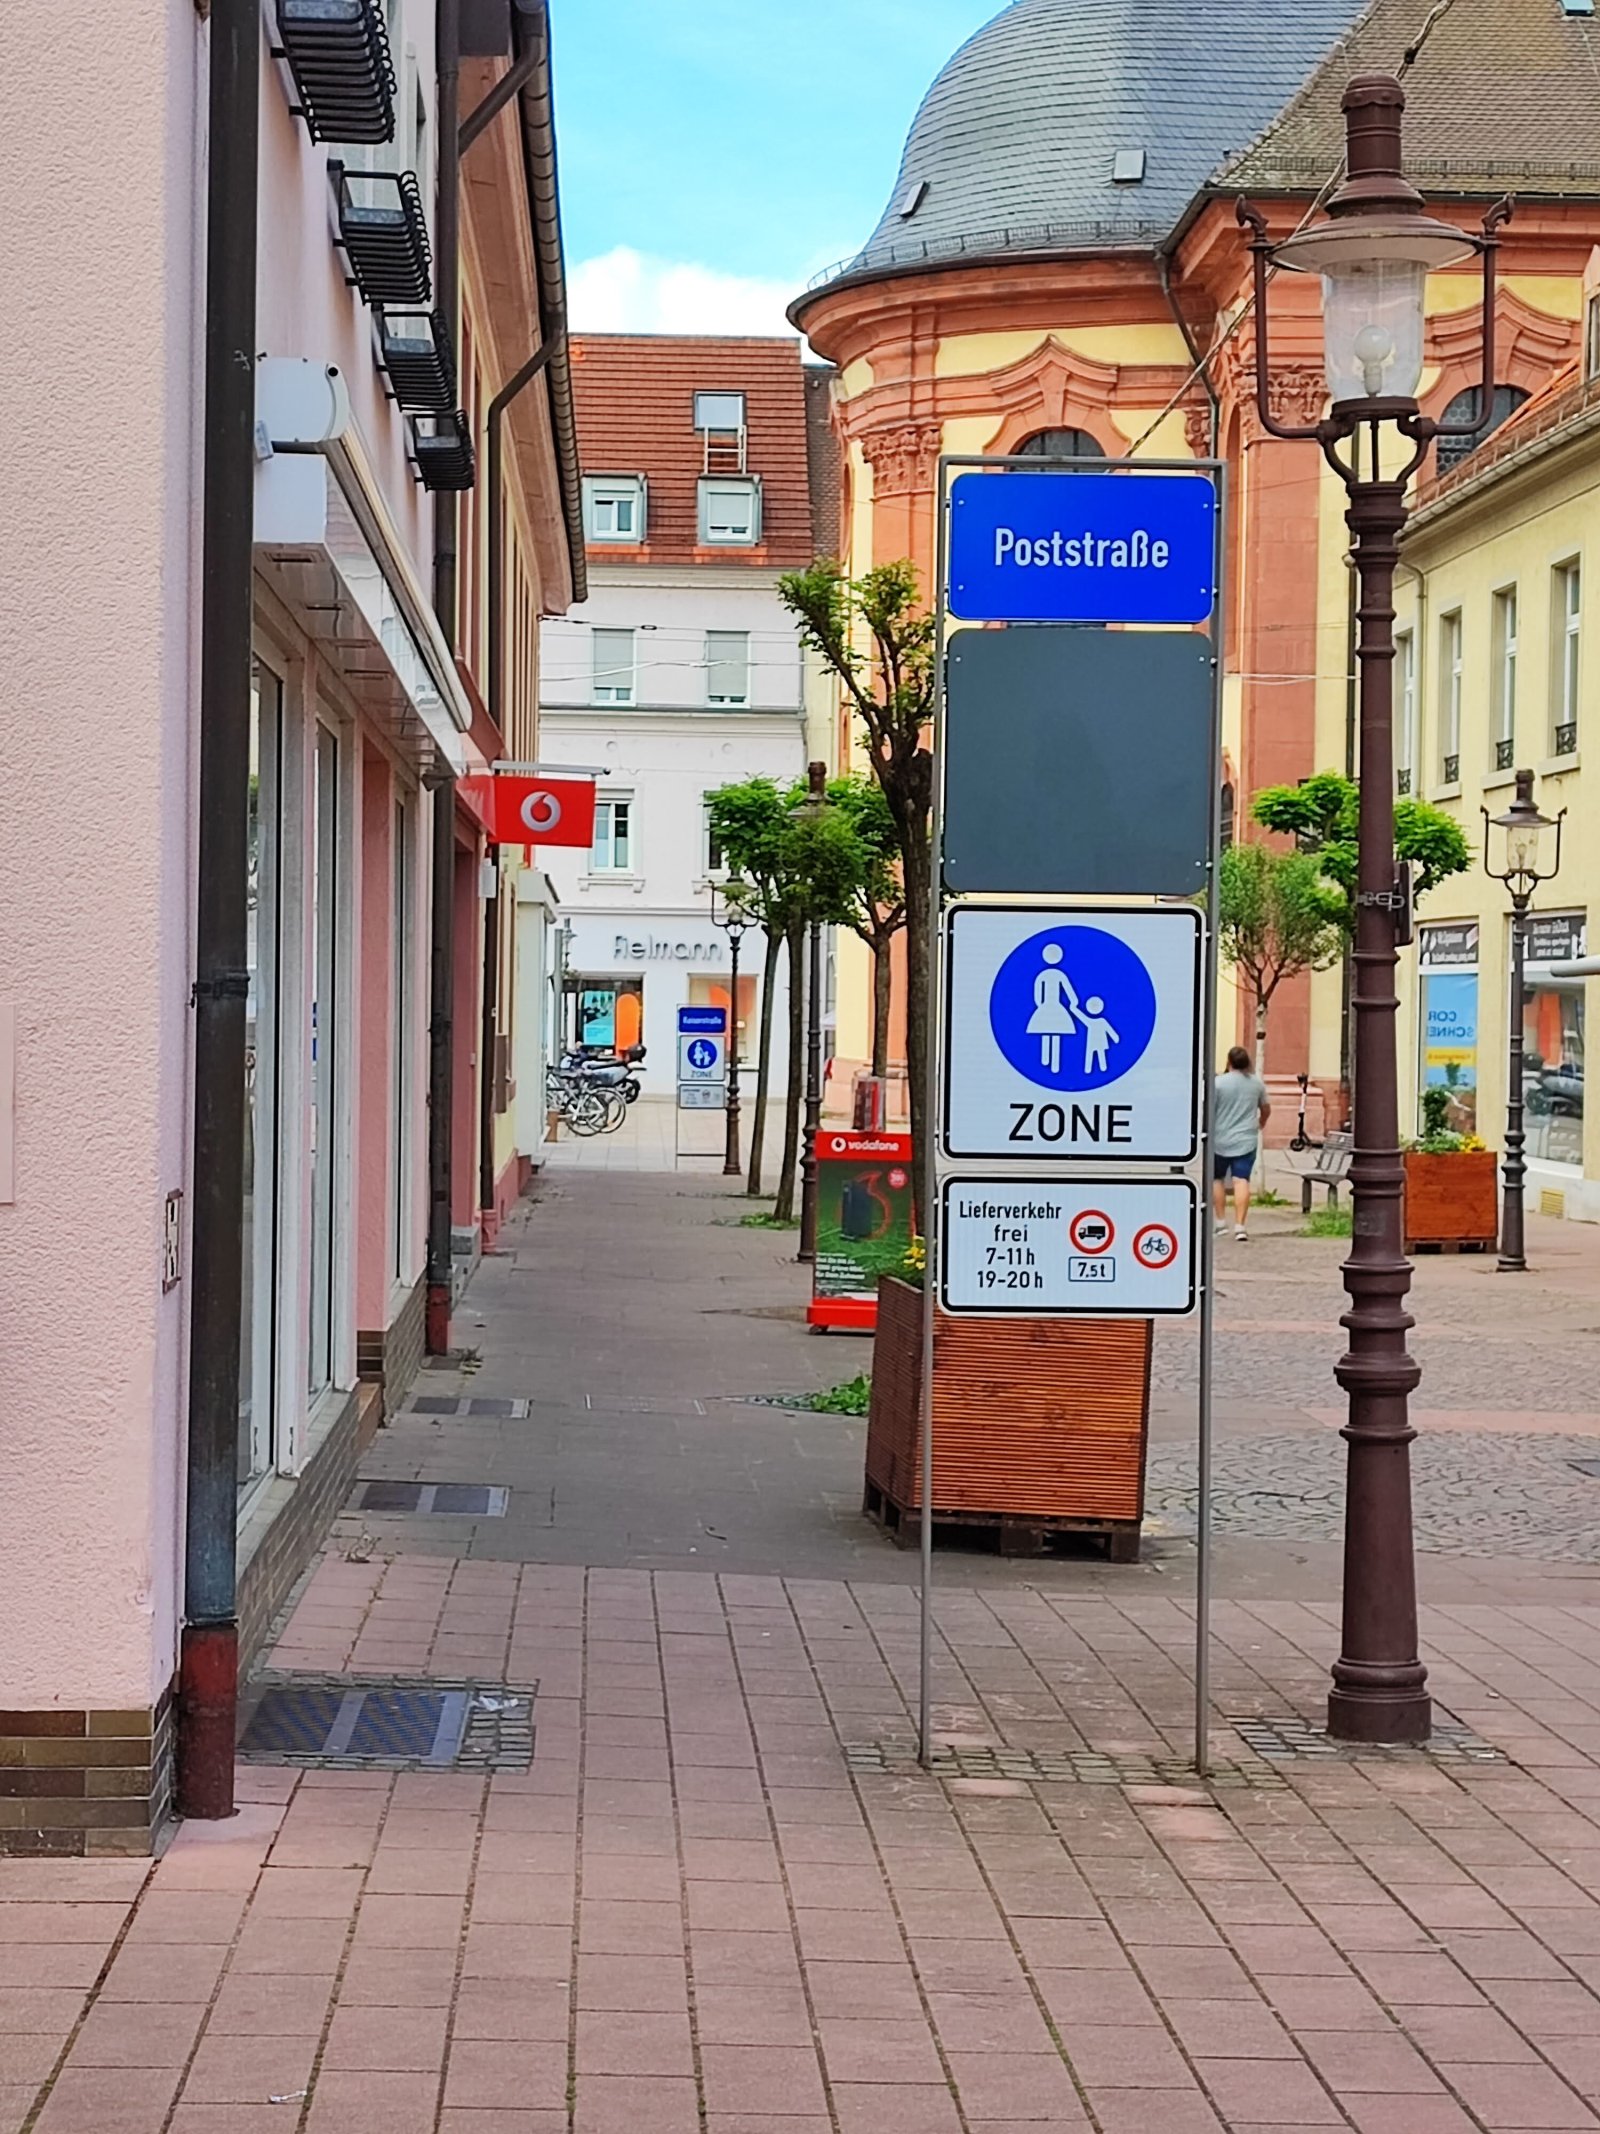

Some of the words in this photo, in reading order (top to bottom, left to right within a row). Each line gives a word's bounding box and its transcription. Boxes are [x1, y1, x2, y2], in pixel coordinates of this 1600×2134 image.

[995, 528, 1169, 568] Poststraße
[1008, 1103, 1133, 1143] ZONE
[848, 1140, 900, 1151] vodafone
[959, 1200, 1062, 1220] Lieferverkehr
[994, 1224, 1028, 1242] frei
